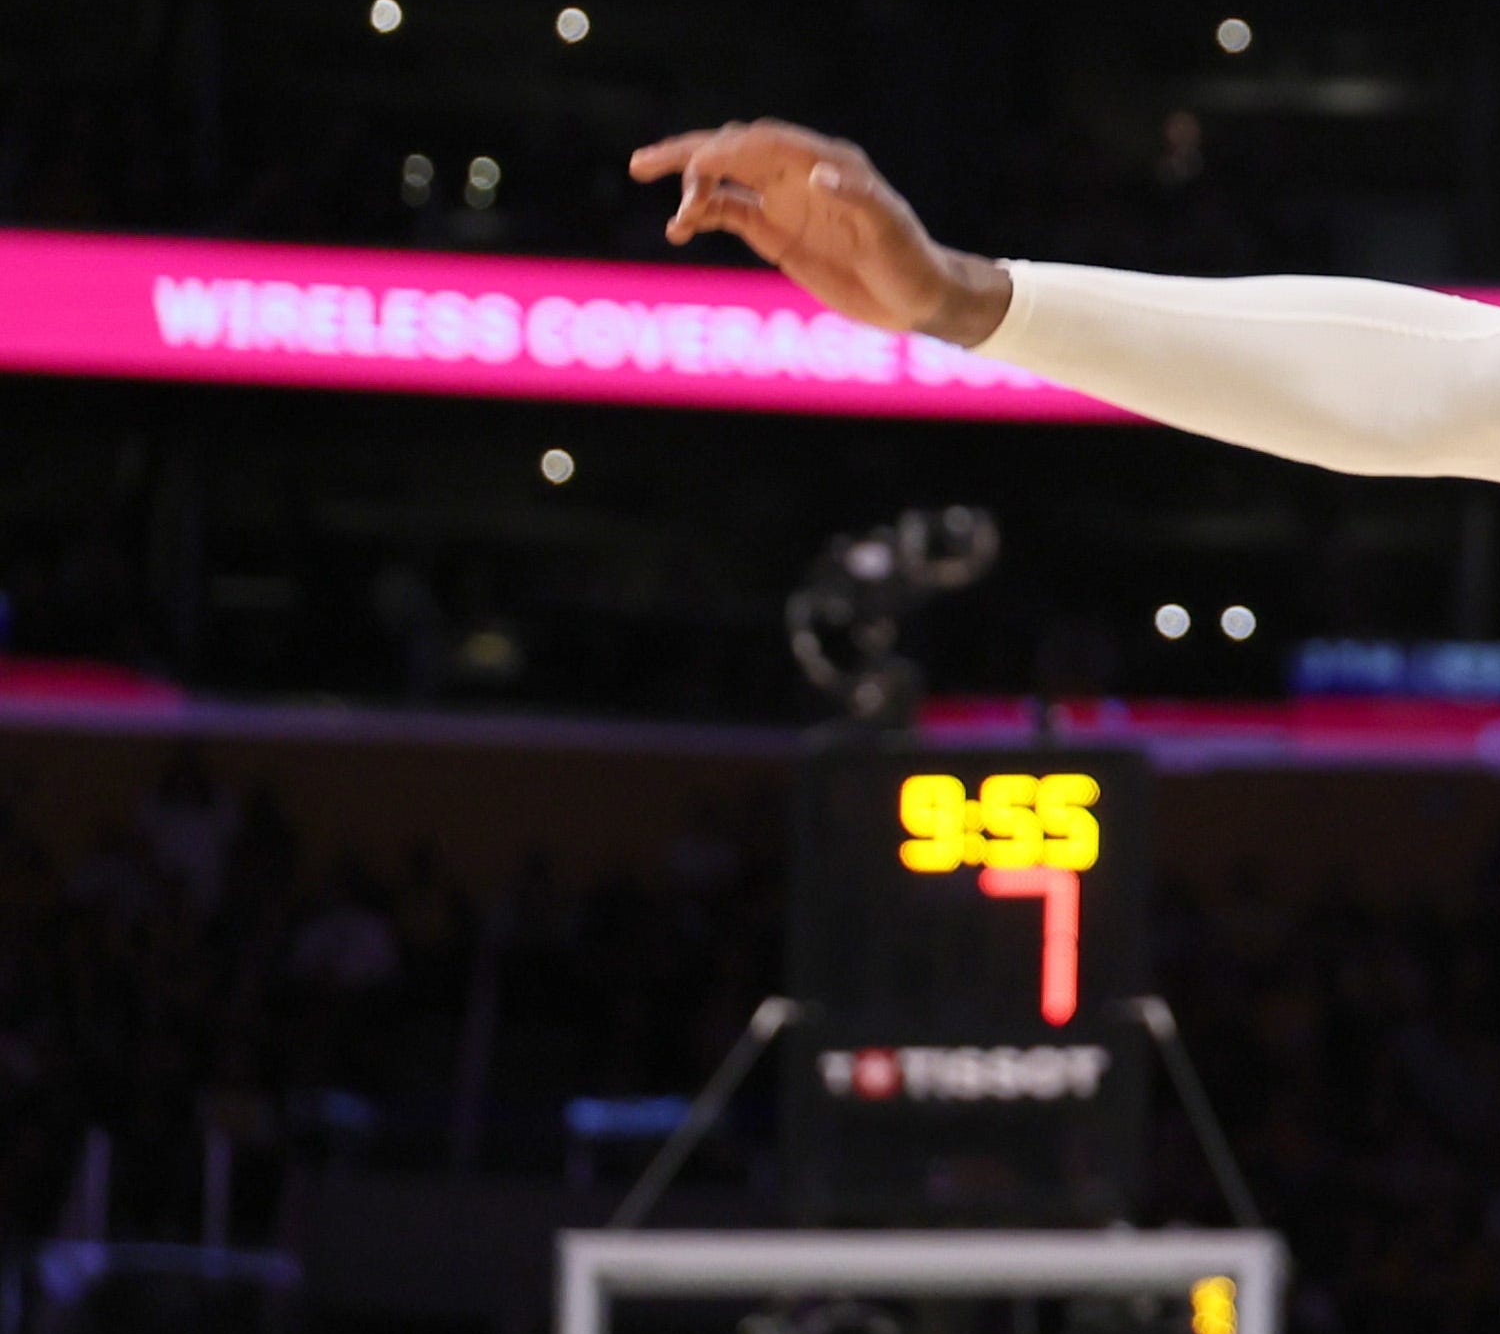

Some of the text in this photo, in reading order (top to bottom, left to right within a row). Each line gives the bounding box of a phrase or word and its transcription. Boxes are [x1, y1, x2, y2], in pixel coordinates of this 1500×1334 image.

[155, 275, 522, 363] WIRELESS
[525, 296, 899, 383] COVERAGE
[900, 772, 1100, 873] 9:55
[978, 865, 1081, 1027] 7
